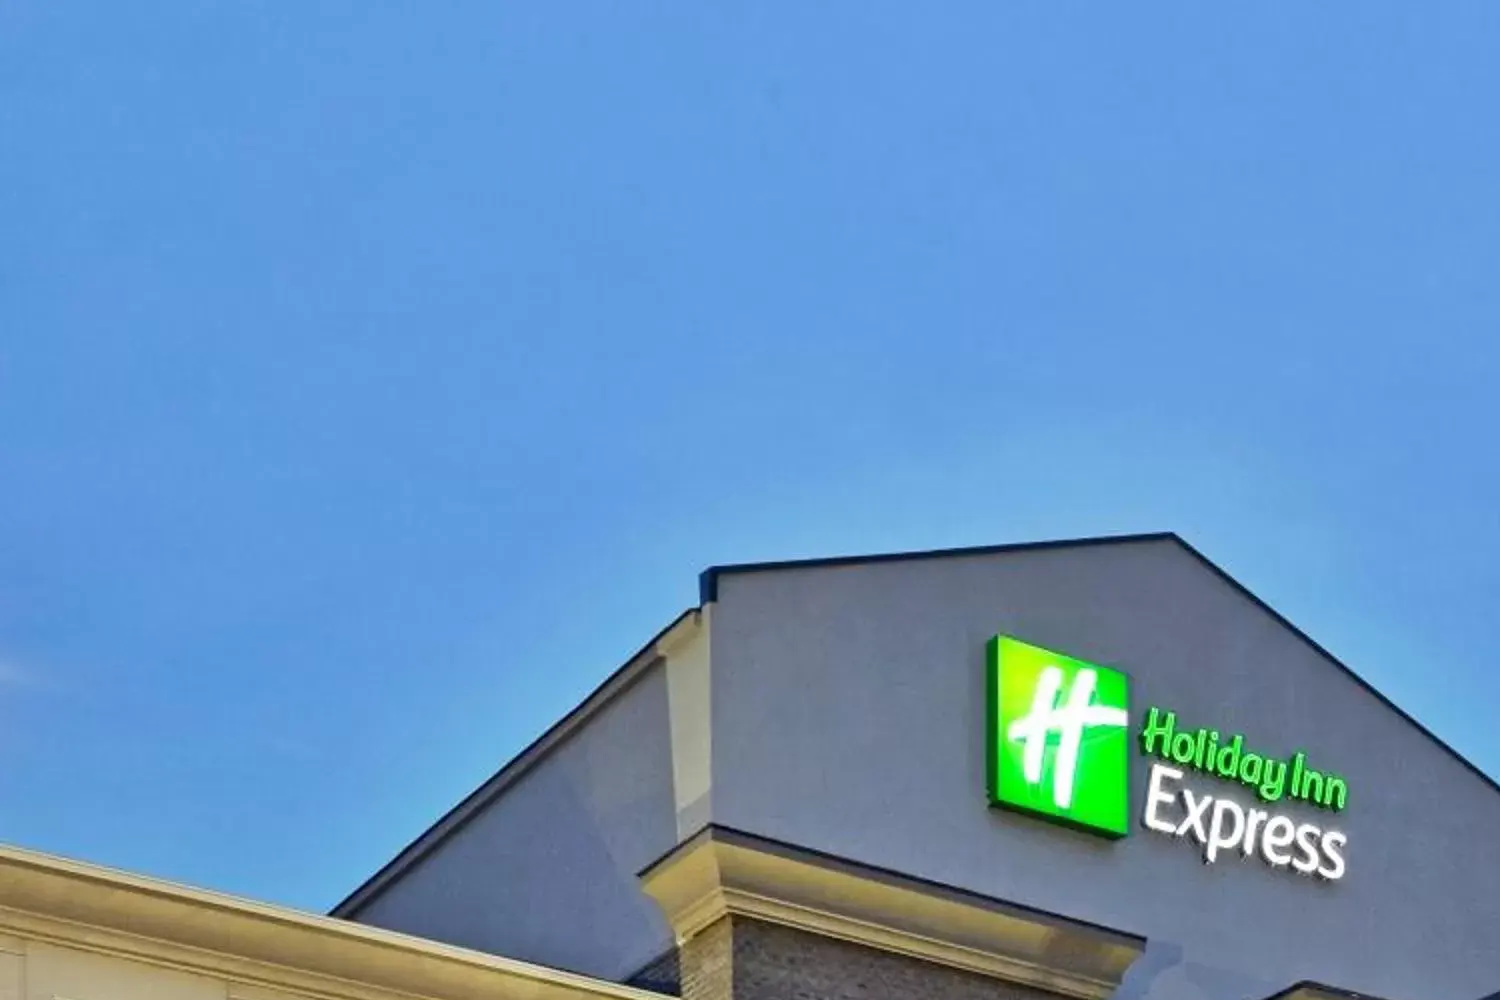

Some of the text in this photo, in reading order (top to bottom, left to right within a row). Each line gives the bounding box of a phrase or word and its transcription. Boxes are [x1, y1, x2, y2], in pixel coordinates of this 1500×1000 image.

[1006, 666, 1128, 809] H
[1143, 707, 1348, 809] Holiday Inn
[1144, 763, 1348, 880] Express
